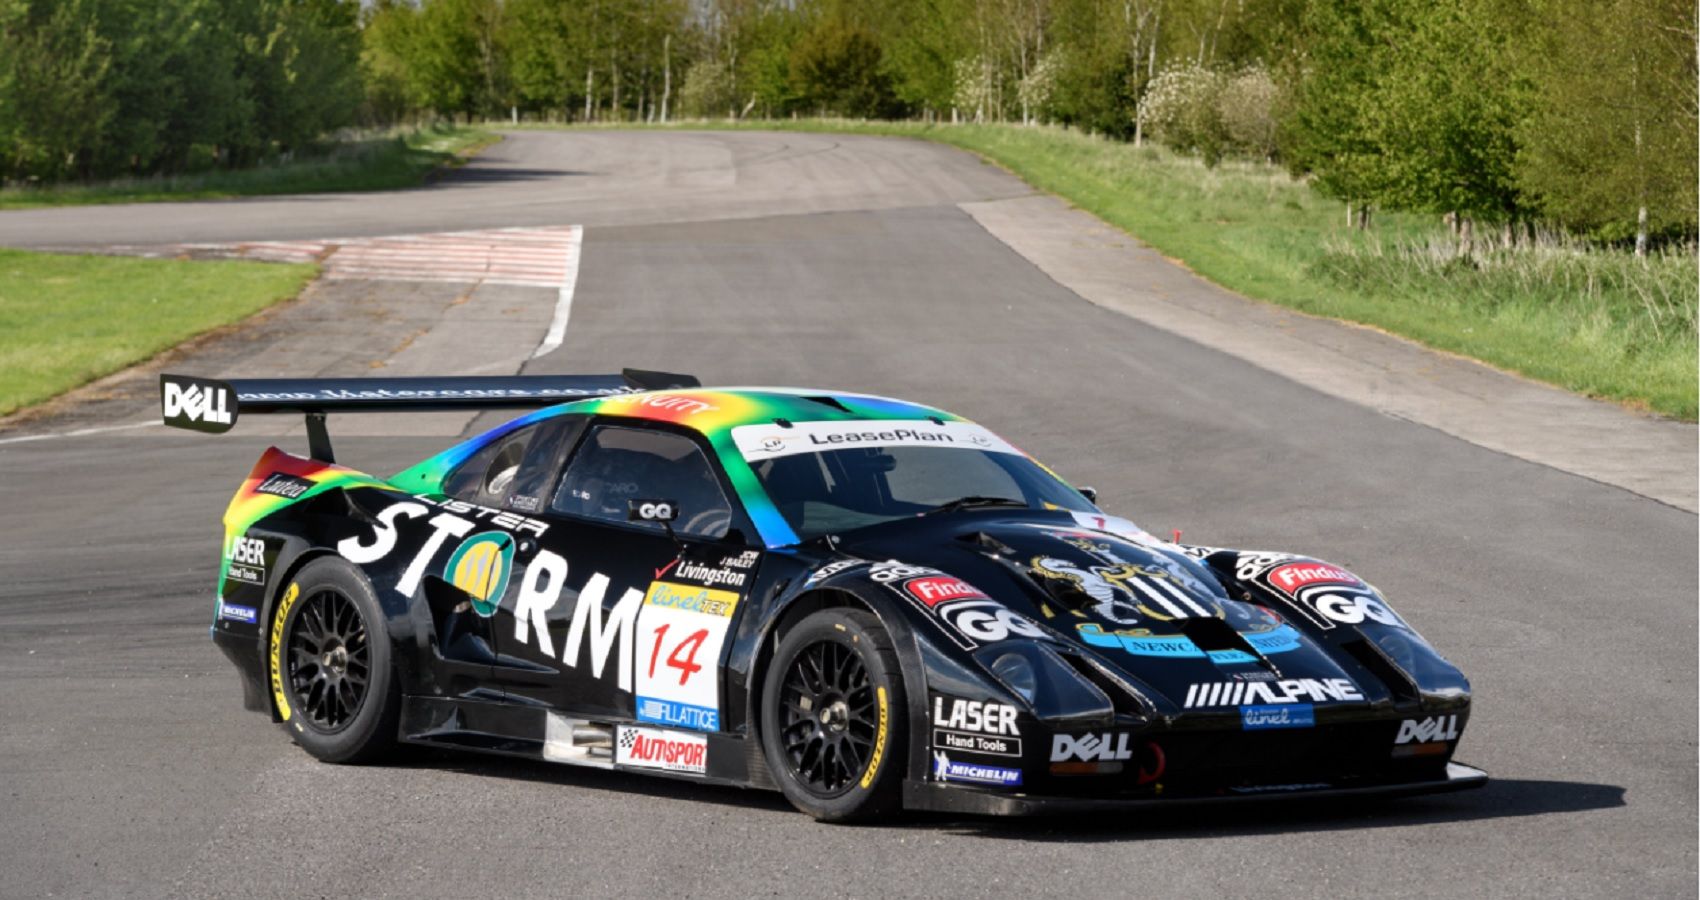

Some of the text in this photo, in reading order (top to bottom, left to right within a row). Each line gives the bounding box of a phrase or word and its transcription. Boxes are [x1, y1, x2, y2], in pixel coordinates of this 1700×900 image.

[164, 382, 232, 424] DELL
[809, 429, 954, 445] LeasePlan
[256, 474, 308, 499] Lutea
[413, 493, 550, 538] LISTER
[639, 503, 672, 519] GQ
[225, 536, 265, 567] LASER
[674, 561, 746, 586] Livingston
[337, 501, 645, 693] STORM
[1315, 594, 1398, 626] GQ
[956, 608, 1056, 641] GQ
[648, 623, 709, 686] 14
[1243, 678, 1364, 704] ALPINE
[933, 697, 1020, 736] LASER
[1245, 707, 1291, 725] linel
[1395, 714, 1460, 744] DELL
[946, 735, 1007, 752] Hand Tools
[1050, 732, 1133, 762] DELL
[950, 765, 1019, 782] MICHELIN
